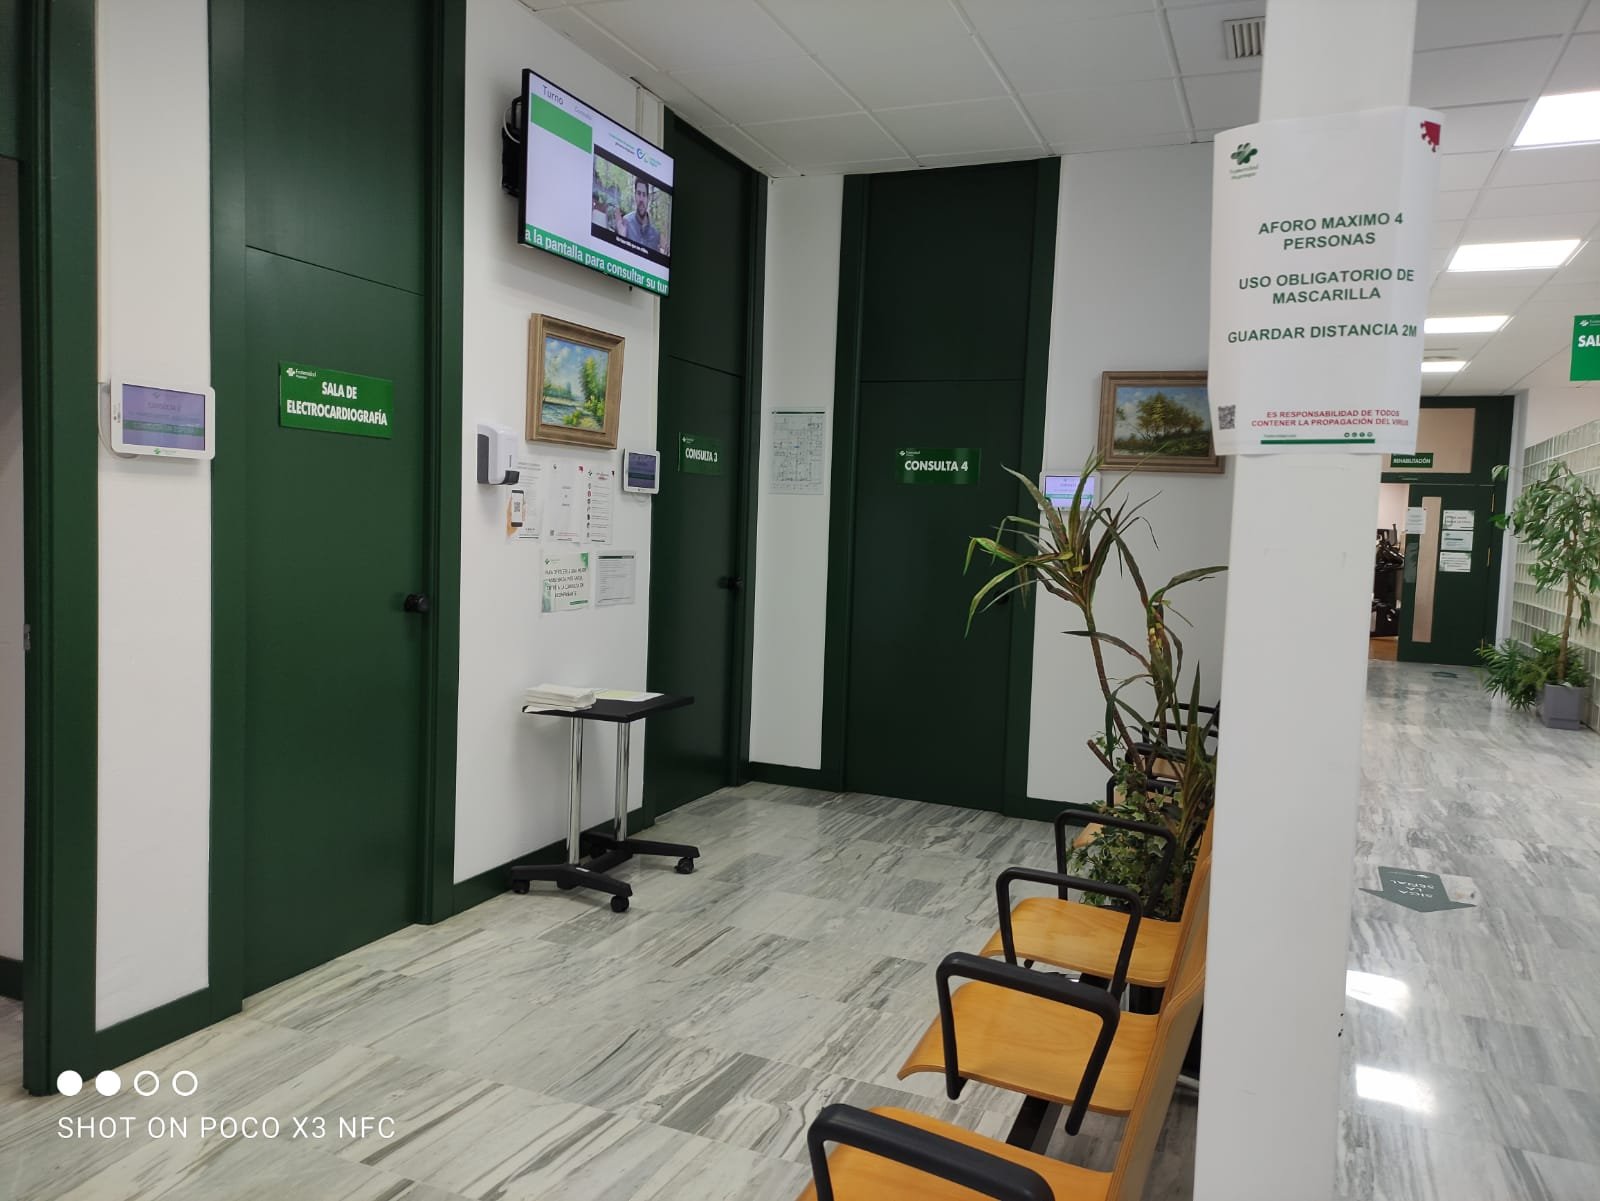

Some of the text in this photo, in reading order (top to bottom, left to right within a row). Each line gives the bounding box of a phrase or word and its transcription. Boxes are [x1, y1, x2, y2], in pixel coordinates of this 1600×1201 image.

[542, 84, 564, 105] Turno
[1258, 212, 1403, 235] AFORO MAXIMO 4
[1283, 232, 1376, 250] PERSONAS
[533, 229, 543, 246] la
[545, 233, 583, 262] pantalla
[585, 252, 605, 271] para
[607, 262, 645, 286] consultar
[646, 276, 656, 291] su
[1239, 268, 1414, 290] USO OBLIGATORIO DE
[1272, 287, 1381, 304] MASCARILLA
[1228, 323, 1417, 343] GUARDAR DISTANCIA 2M
[321, 381, 357, 400] SALA DE
[286, 399, 388, 426] ELECTROCARDIOGRAFÍA
[1251, 419, 1296, 427] CONTENER
[1311, 417, 1373, 426] PROPAGACIÓN
[1279, 409, 1359, 418] RESPONSABILIDAD
[1361, 409, 1373, 417] DE
[1376, 409, 1400, 417] TODOS
[685, 447, 718, 463] CONSULTA 3
[904, 460, 968, 472] CONSULTA 4
